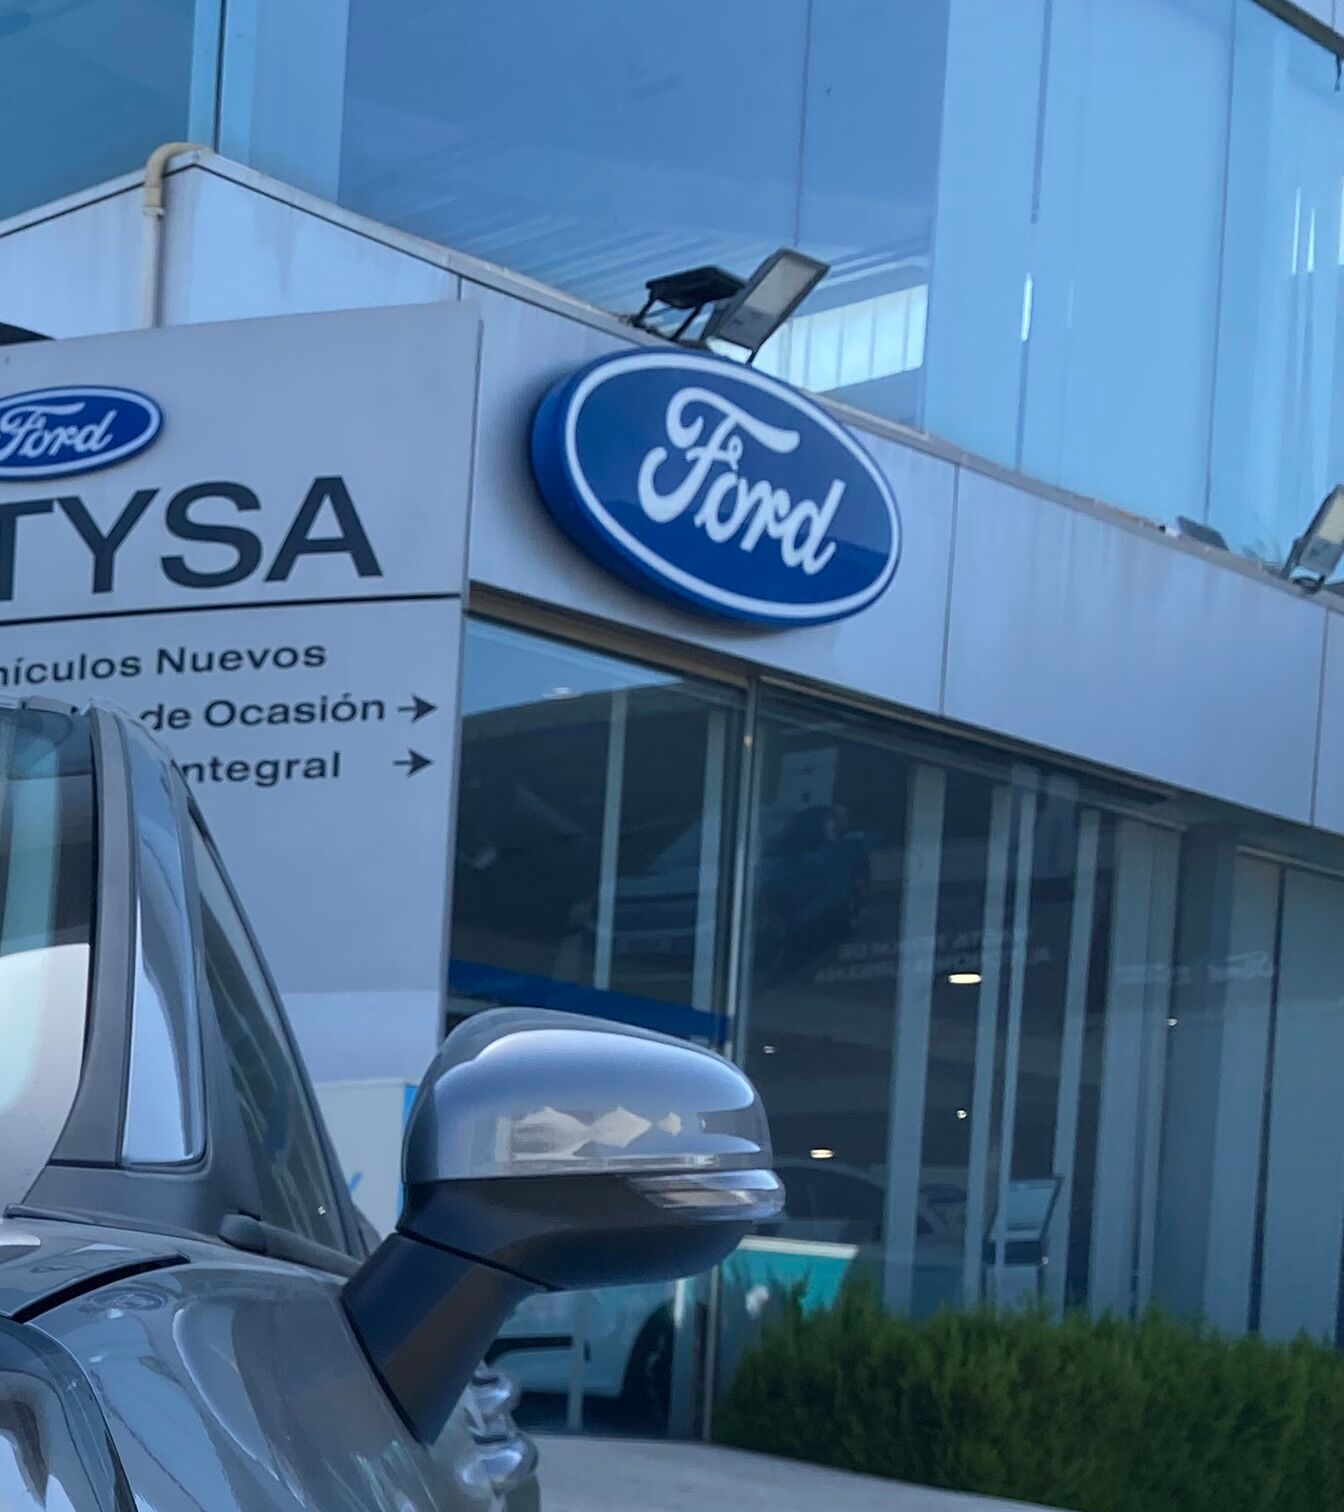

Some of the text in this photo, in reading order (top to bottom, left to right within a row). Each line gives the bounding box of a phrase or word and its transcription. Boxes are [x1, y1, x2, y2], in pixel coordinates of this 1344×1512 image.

[637, 386, 847, 575] Ford
[156, 644, 327, 675] Nuevos
[139, 692, 385, 731] de Ocasión
[180, 750, 341, 788] ntegral
